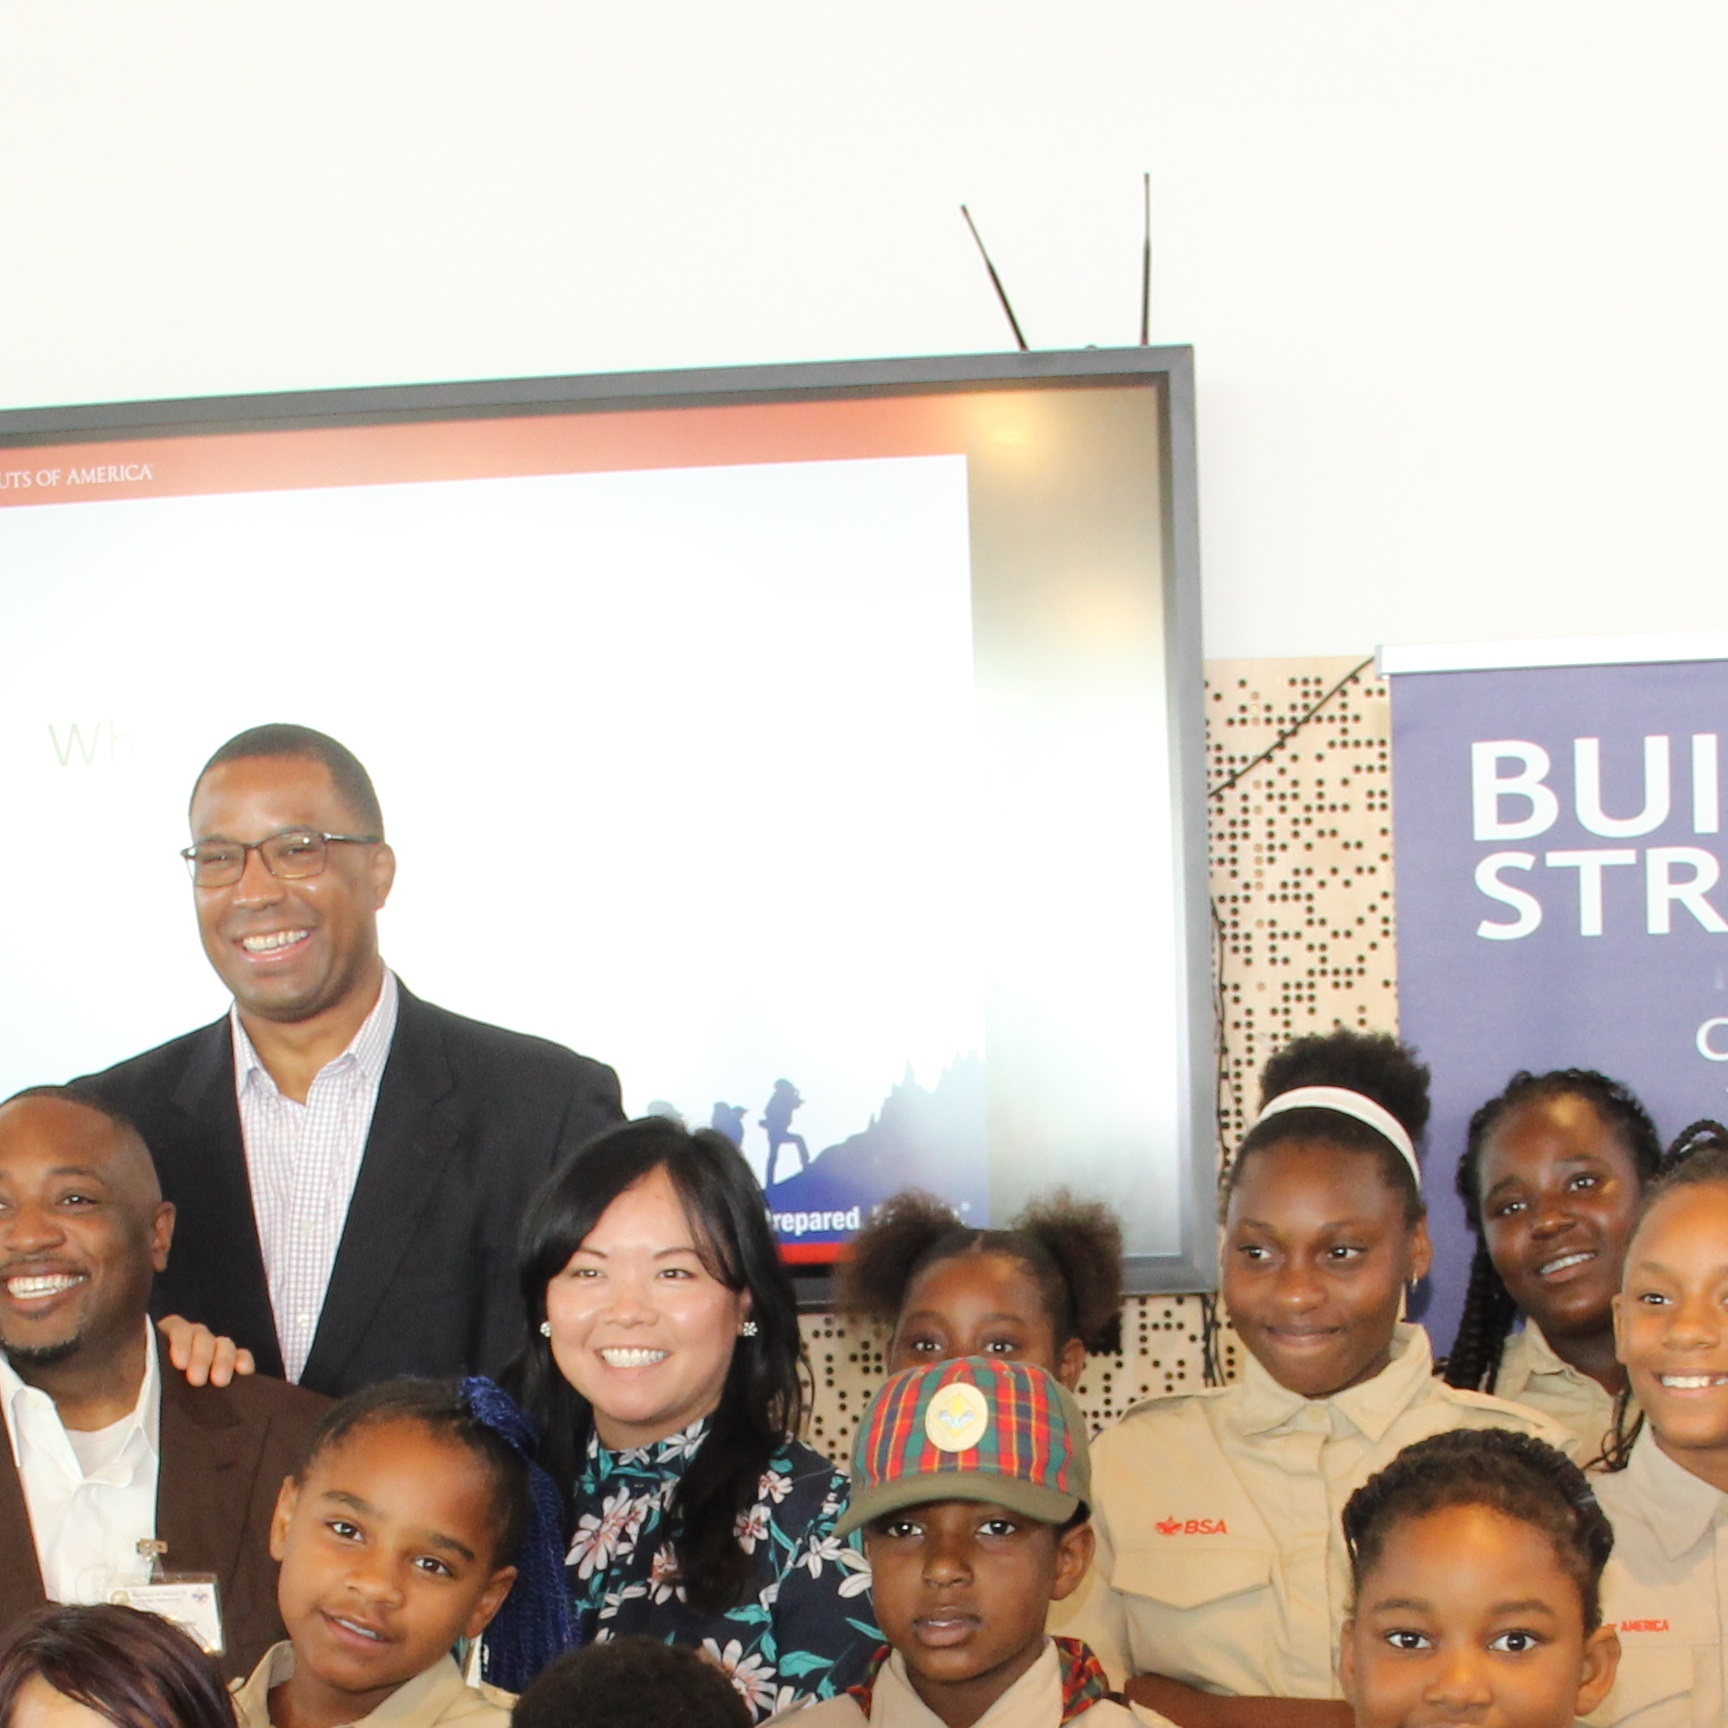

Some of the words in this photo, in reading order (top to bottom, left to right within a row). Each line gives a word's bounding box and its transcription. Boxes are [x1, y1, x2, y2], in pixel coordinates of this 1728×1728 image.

[36, 469, 61, 487] OF
[66, 464, 153, 485] AMERICA
[765, 1206, 860, 1236] repared
[1184, 1518, 1228, 1535] BSA
